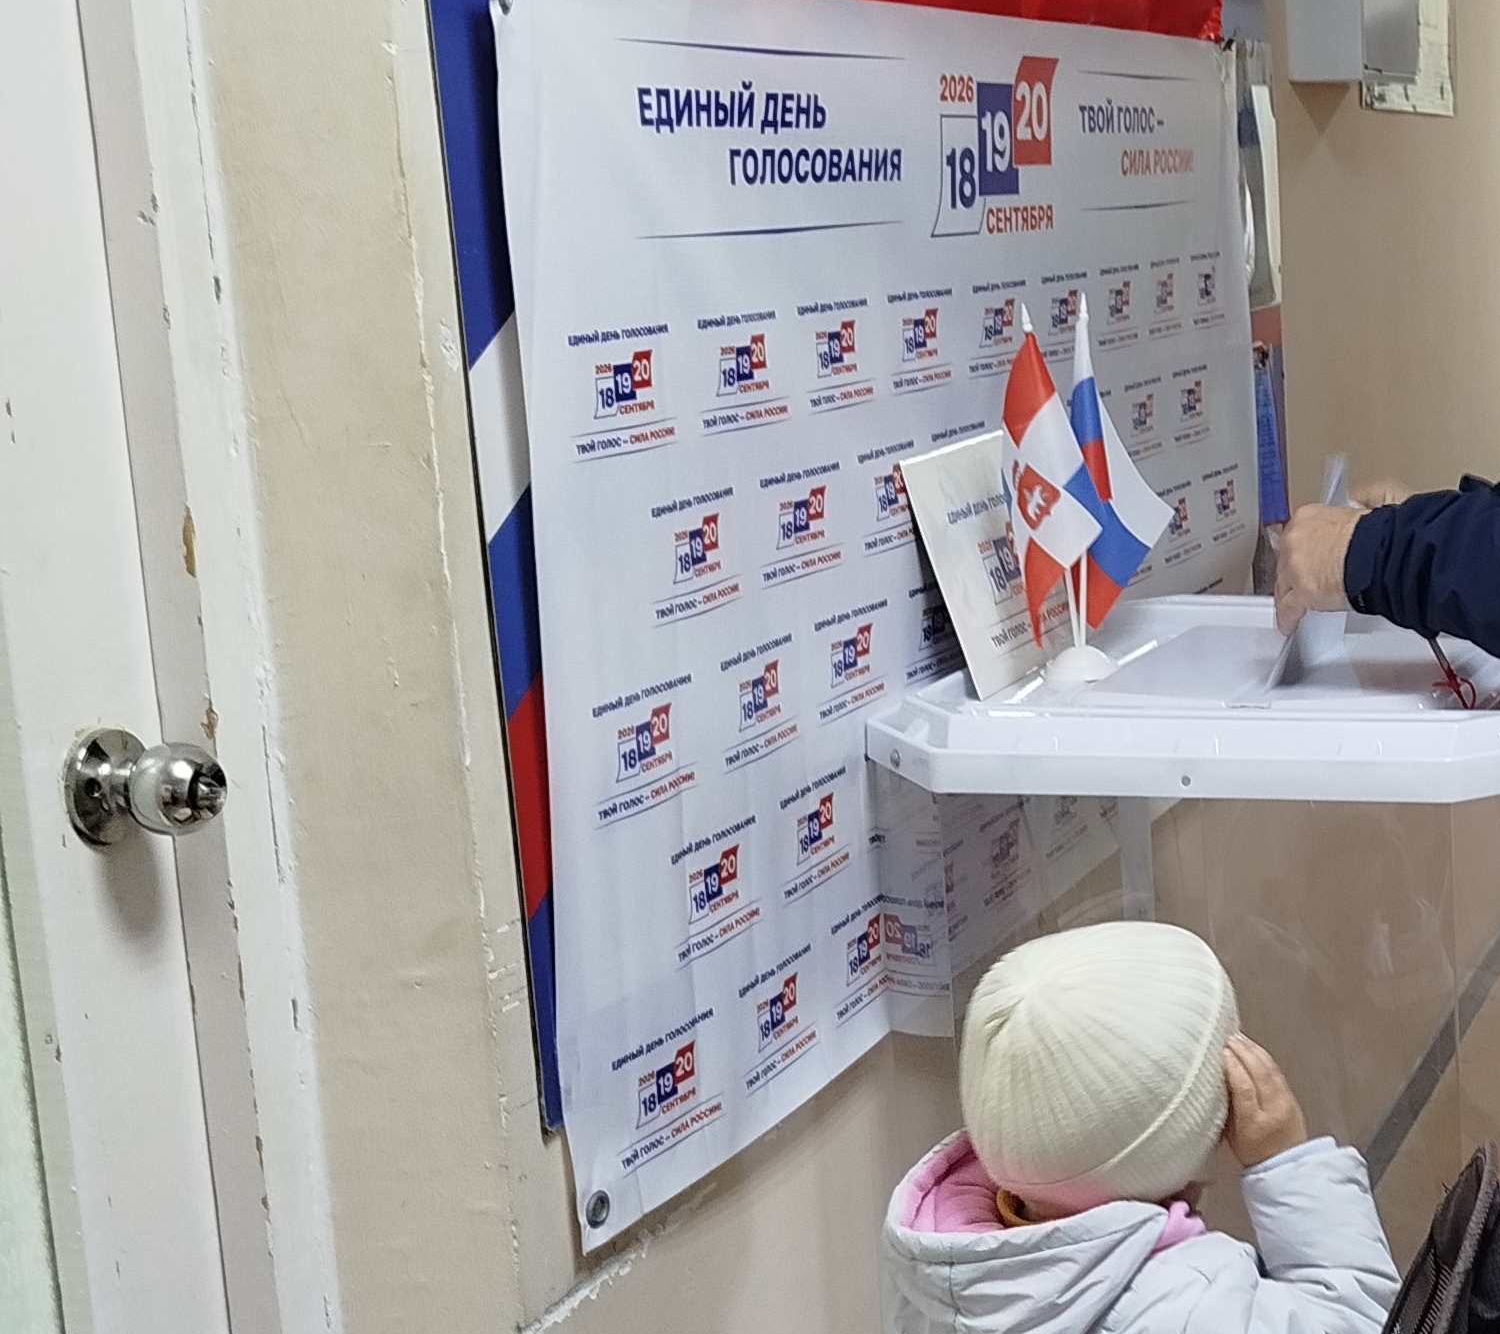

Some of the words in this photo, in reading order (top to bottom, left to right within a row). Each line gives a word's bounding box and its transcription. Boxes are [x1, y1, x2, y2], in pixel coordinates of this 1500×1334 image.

[940, 74, 974, 103] 2026
[637, 80, 755, 134] ЕДИНЫЙ
[760, 92, 827, 135] ДЕНЬ
[1078, 98, 1115, 134] ТВОЙ
[1117, 106, 1155, 133] ГОЛОС
[946, 147, 976, 209] 18
[981, 111, 1011, 172] 19
[1015, 81, 1048, 141] 20
[729, 148, 902, 186] ГОЛОСОВАНИЯ
[1121, 150, 1150, 177] СИЛА
[986, 204, 1054, 234] СЕНТЯБРЯ
[568, 330, 600, 346] ЕДИНЫЙ
[601, 330, 620, 343] ДЕНЬ
[622, 324, 669, 339] ГОЛОСОВАНИЯ
[599, 388, 614, 409] 18
[616, 373, 631, 395] 19
[632, 359, 650, 381] 20
[620, 400, 655, 415] СЕНТЯБРЯ
[576, 440, 596, 455] ТВОЙ
[597, 437, 622, 451] ГОЛОС
[651, 500, 678, 518] ЕДИНЫЙ
[678, 496, 693, 512] ДЕНЬ
[693, 486, 734, 506] ГОЛОСОВАНИЯ
[678, 552, 691, 574] 18
[691, 537, 703, 559] 19
[703, 523, 717, 544] 20
[990, 568, 1006, 592] 18
[592, 696, 623, 718] ЕДИНЫЙ
[624, 692, 640, 708] ДЕНЬ
[641, 674, 692, 700] ГОЛОСОВАНИЯ
[622, 748, 637, 771] 18
[638, 730, 651, 754] 19
[652, 713, 668, 737] 20
[641, 750, 673, 773] СЕНТЯБРЯ
[598, 803, 618, 821] ТВОЙ
[619, 795, 645, 813] ГОЛОС
[612, 1045, 644, 1071] ЕДИНЫЙ
[645, 1037, 664, 1055] ДЕНЬ
[665, 1008, 714, 1043] ГОЛОСОВАНИЯ
[642, 1093, 656, 1117] 18
[659, 1072, 673, 1096] 19
[675, 1051, 693, 1077] 20
[661, 1087, 696, 1114] СЕНТЯБРЯ
[621, 1151, 639, 1169] ТВОЙ
[640, 1136, 665, 1159] ГОЛОС
[671, 1123, 690, 1138] СИЛА
